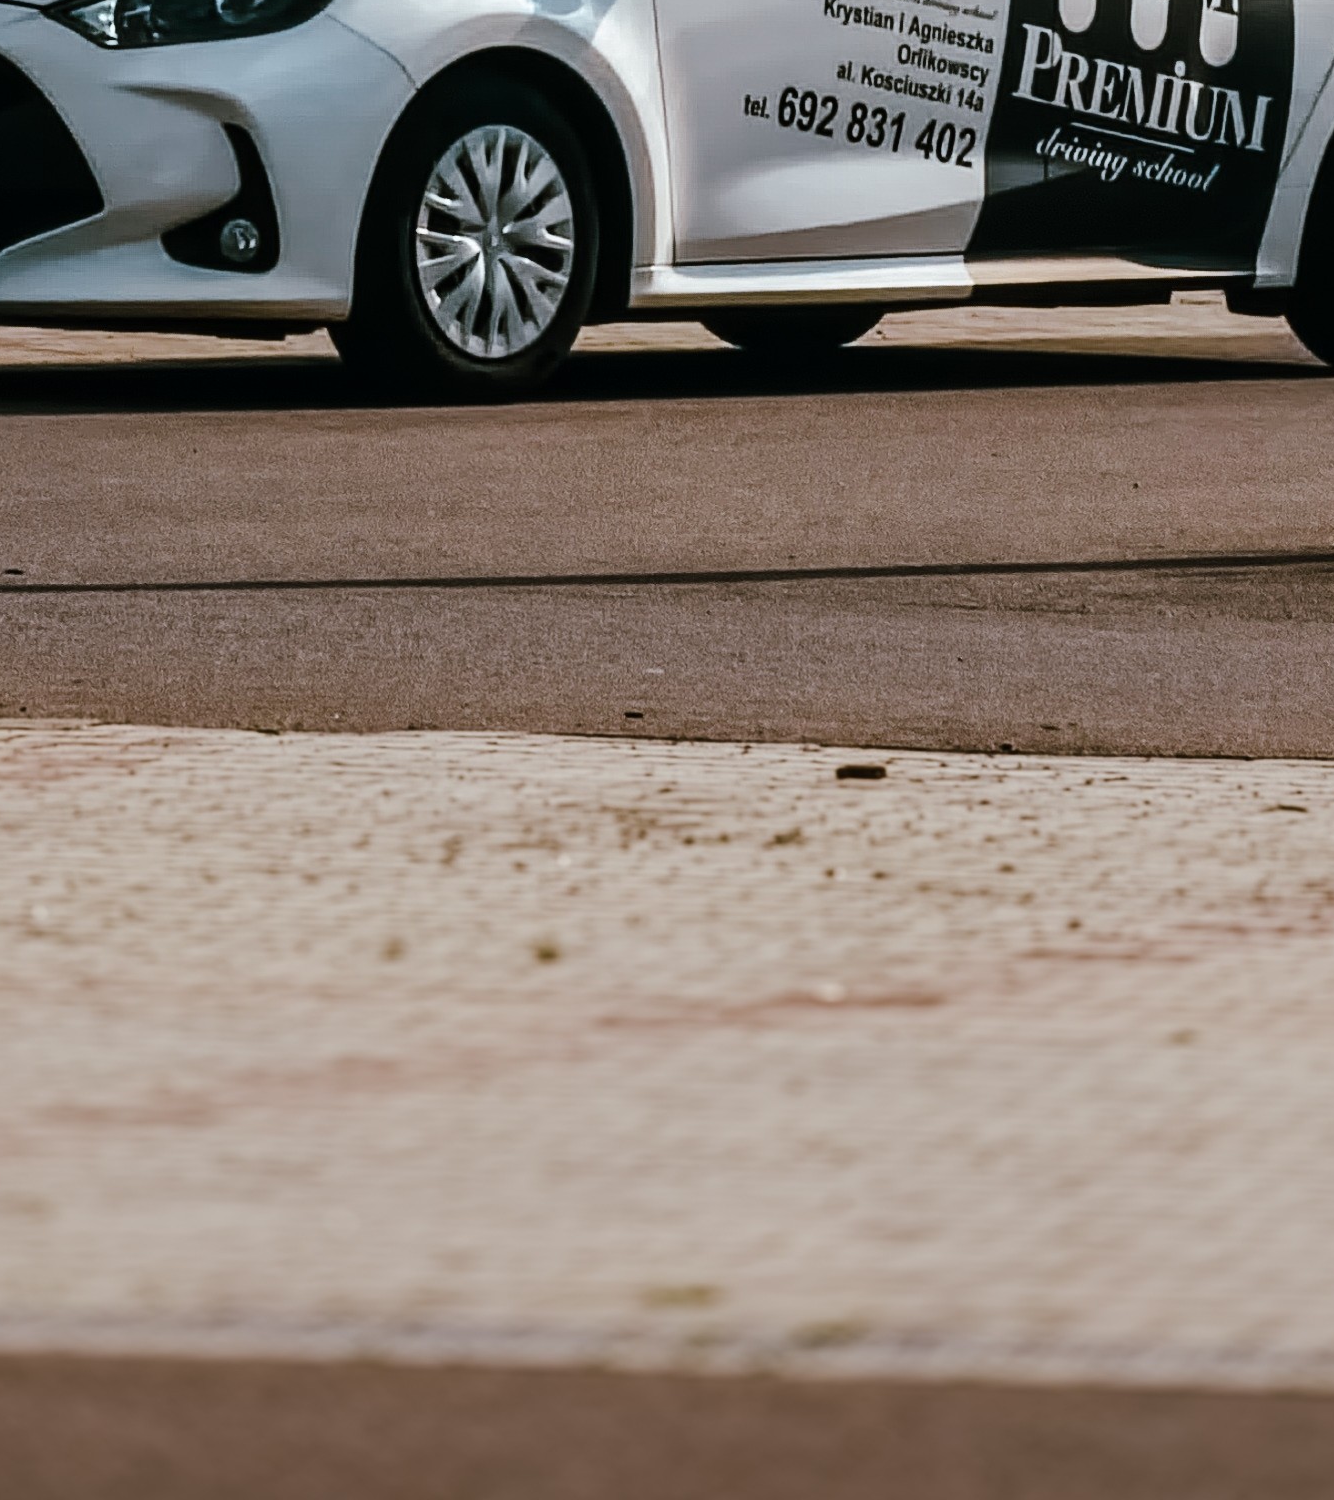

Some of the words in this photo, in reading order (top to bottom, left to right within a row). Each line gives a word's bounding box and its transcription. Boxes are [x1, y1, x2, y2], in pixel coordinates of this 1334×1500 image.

[908, 15, 995, 54] Agnieszka
[837, 60, 856, 84] al.
[958, 87, 985, 113] 14a
[897, 44, 989, 88] Orlikowscy
[744, 94, 771, 119] tel.
[778, 86, 839, 138] 692
[846, 102, 907, 153] 831
[915, 119, 977, 168] 402
[1036, 127, 1128, 182] driving
[1132, 153, 1220, 192] school
